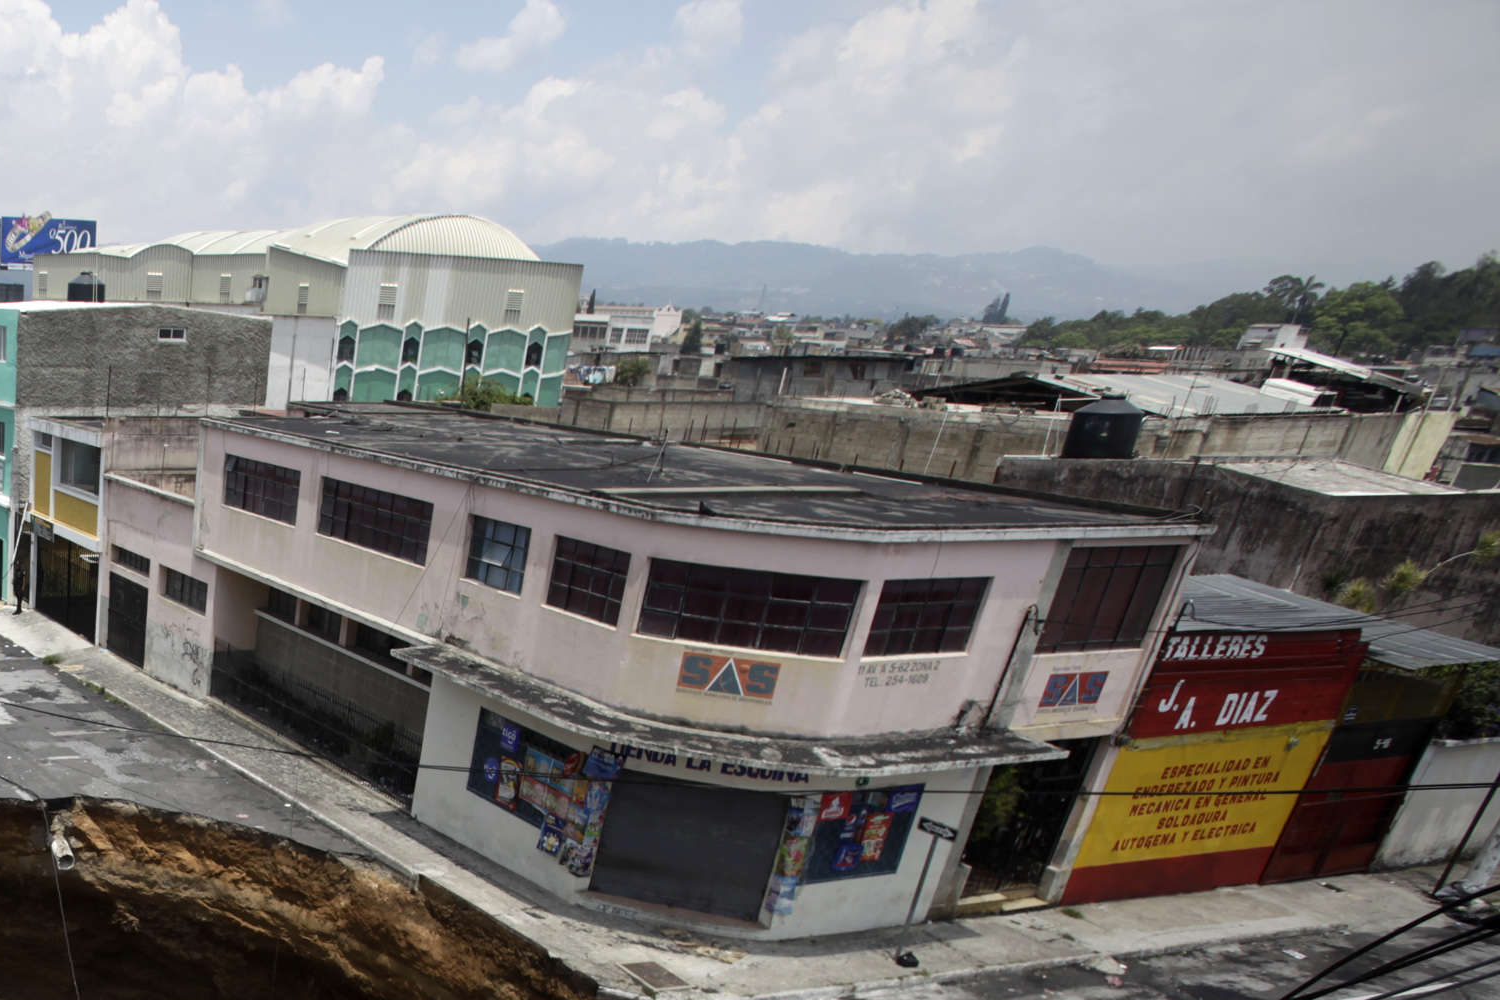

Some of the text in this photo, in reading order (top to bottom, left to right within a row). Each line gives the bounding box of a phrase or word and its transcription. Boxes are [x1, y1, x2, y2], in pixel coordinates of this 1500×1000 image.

[1163, 634, 1268, 661] TALLERES
[681, 655, 779, 695] SAS
[1041, 674, 1107, 705] SAS
[1158, 679, 1279, 729] J. A. DIAZ
[686, 756, 711, 772] LA
[1161, 756, 1272, 780] ESPECIALIDAD EN
[1132, 771, 1281, 800] ENDEREZADO Y PINTURA
[1129, 789, 1268, 817] MECANICA EN GENERAL
[1156, 810, 1228, 830] SOLDADURA
[1111, 822, 1257, 852] AUTOGENA Y ELECTRICA
